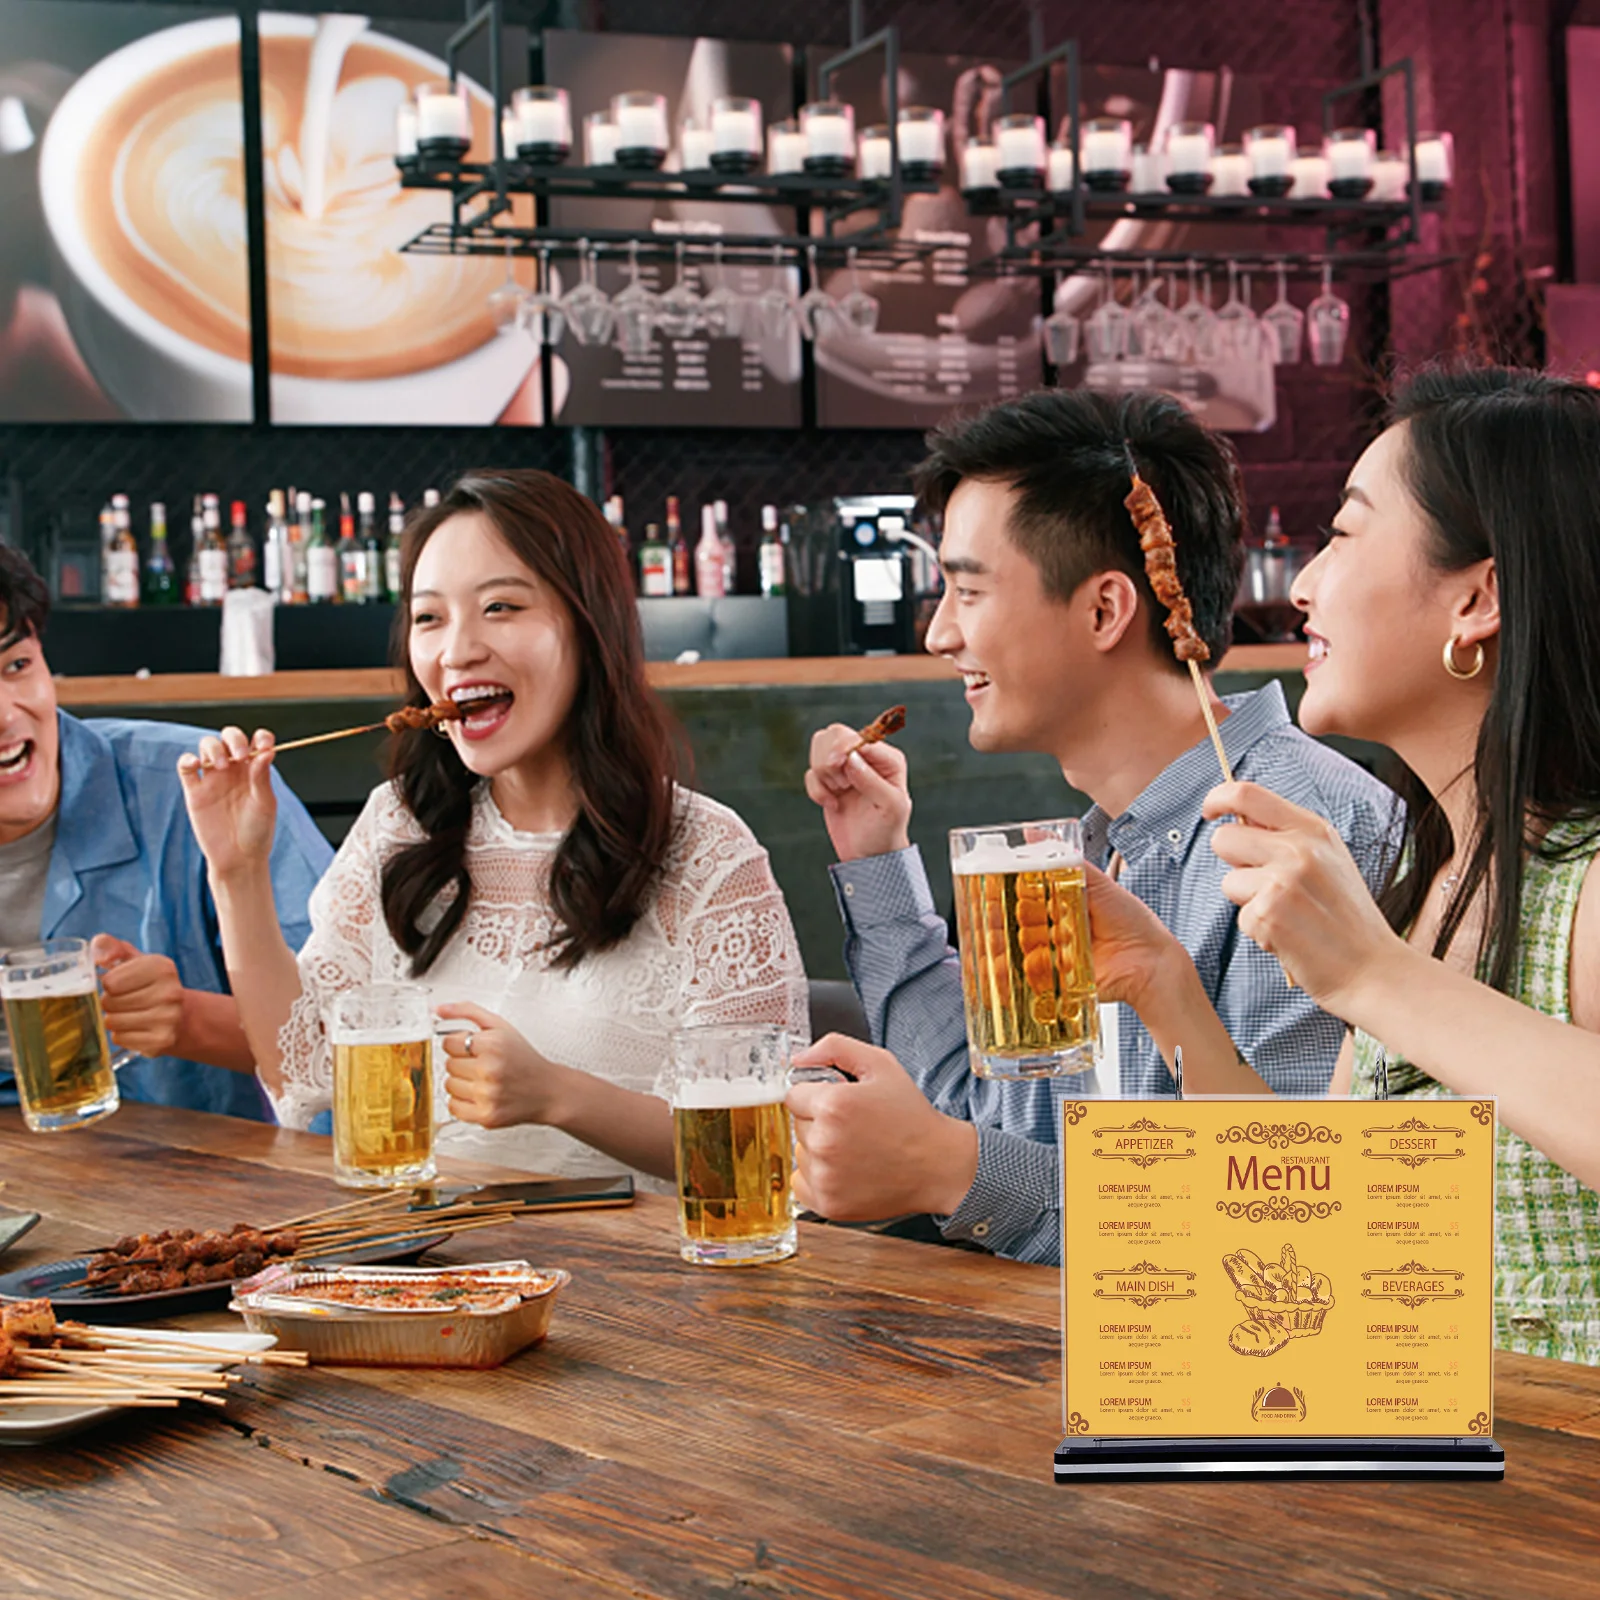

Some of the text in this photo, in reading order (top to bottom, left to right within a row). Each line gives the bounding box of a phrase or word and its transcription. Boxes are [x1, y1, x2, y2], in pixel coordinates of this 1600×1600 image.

[1115, 1138, 1174, 1150] APPETIZER
[1389, 1138, 1438, 1150] DESSERT
[1280, 1156, 1331, 1165] RESTAURANT
[1226, 1155, 1331, 1191] Menu
[1099, 1184, 1125, 1192] LOREM
[1127, 1184, 1151, 1192] IPSUM
[1367, 1184, 1394, 1193] LOREM
[1395, 1184, 1419, 1193] IPSUM
[1099, 1221, 1125, 1229] LOREM
[1127, 1221, 1151, 1229] IPSUM
[1367, 1221, 1393, 1229] LOREM
[1395, 1221, 1419, 1229] IPSUM
[1116, 1280, 1175, 1292] MAIN DISH
[1382, 1280, 1445, 1292] BEVERAGES
[1100, 1324, 1126, 1333] LOREM
[1127, 1324, 1151, 1333] IPSUM
[1367, 1324, 1393, 1333] LOREM
[1395, 1324, 1419, 1333] IPSUM
[1100, 1361, 1126, 1369] LOREM
[1128, 1361, 1151, 1369] IPSUM
[1367, 1361, 1393, 1369] LOREM
[1395, 1361, 1418, 1369] IPSUM
[1100, 1398, 1126, 1406] LOREM
[1128, 1398, 1152, 1406] IPSUM
[1367, 1398, 1393, 1406] LOREM
[1395, 1398, 1418, 1406] IPSUM
